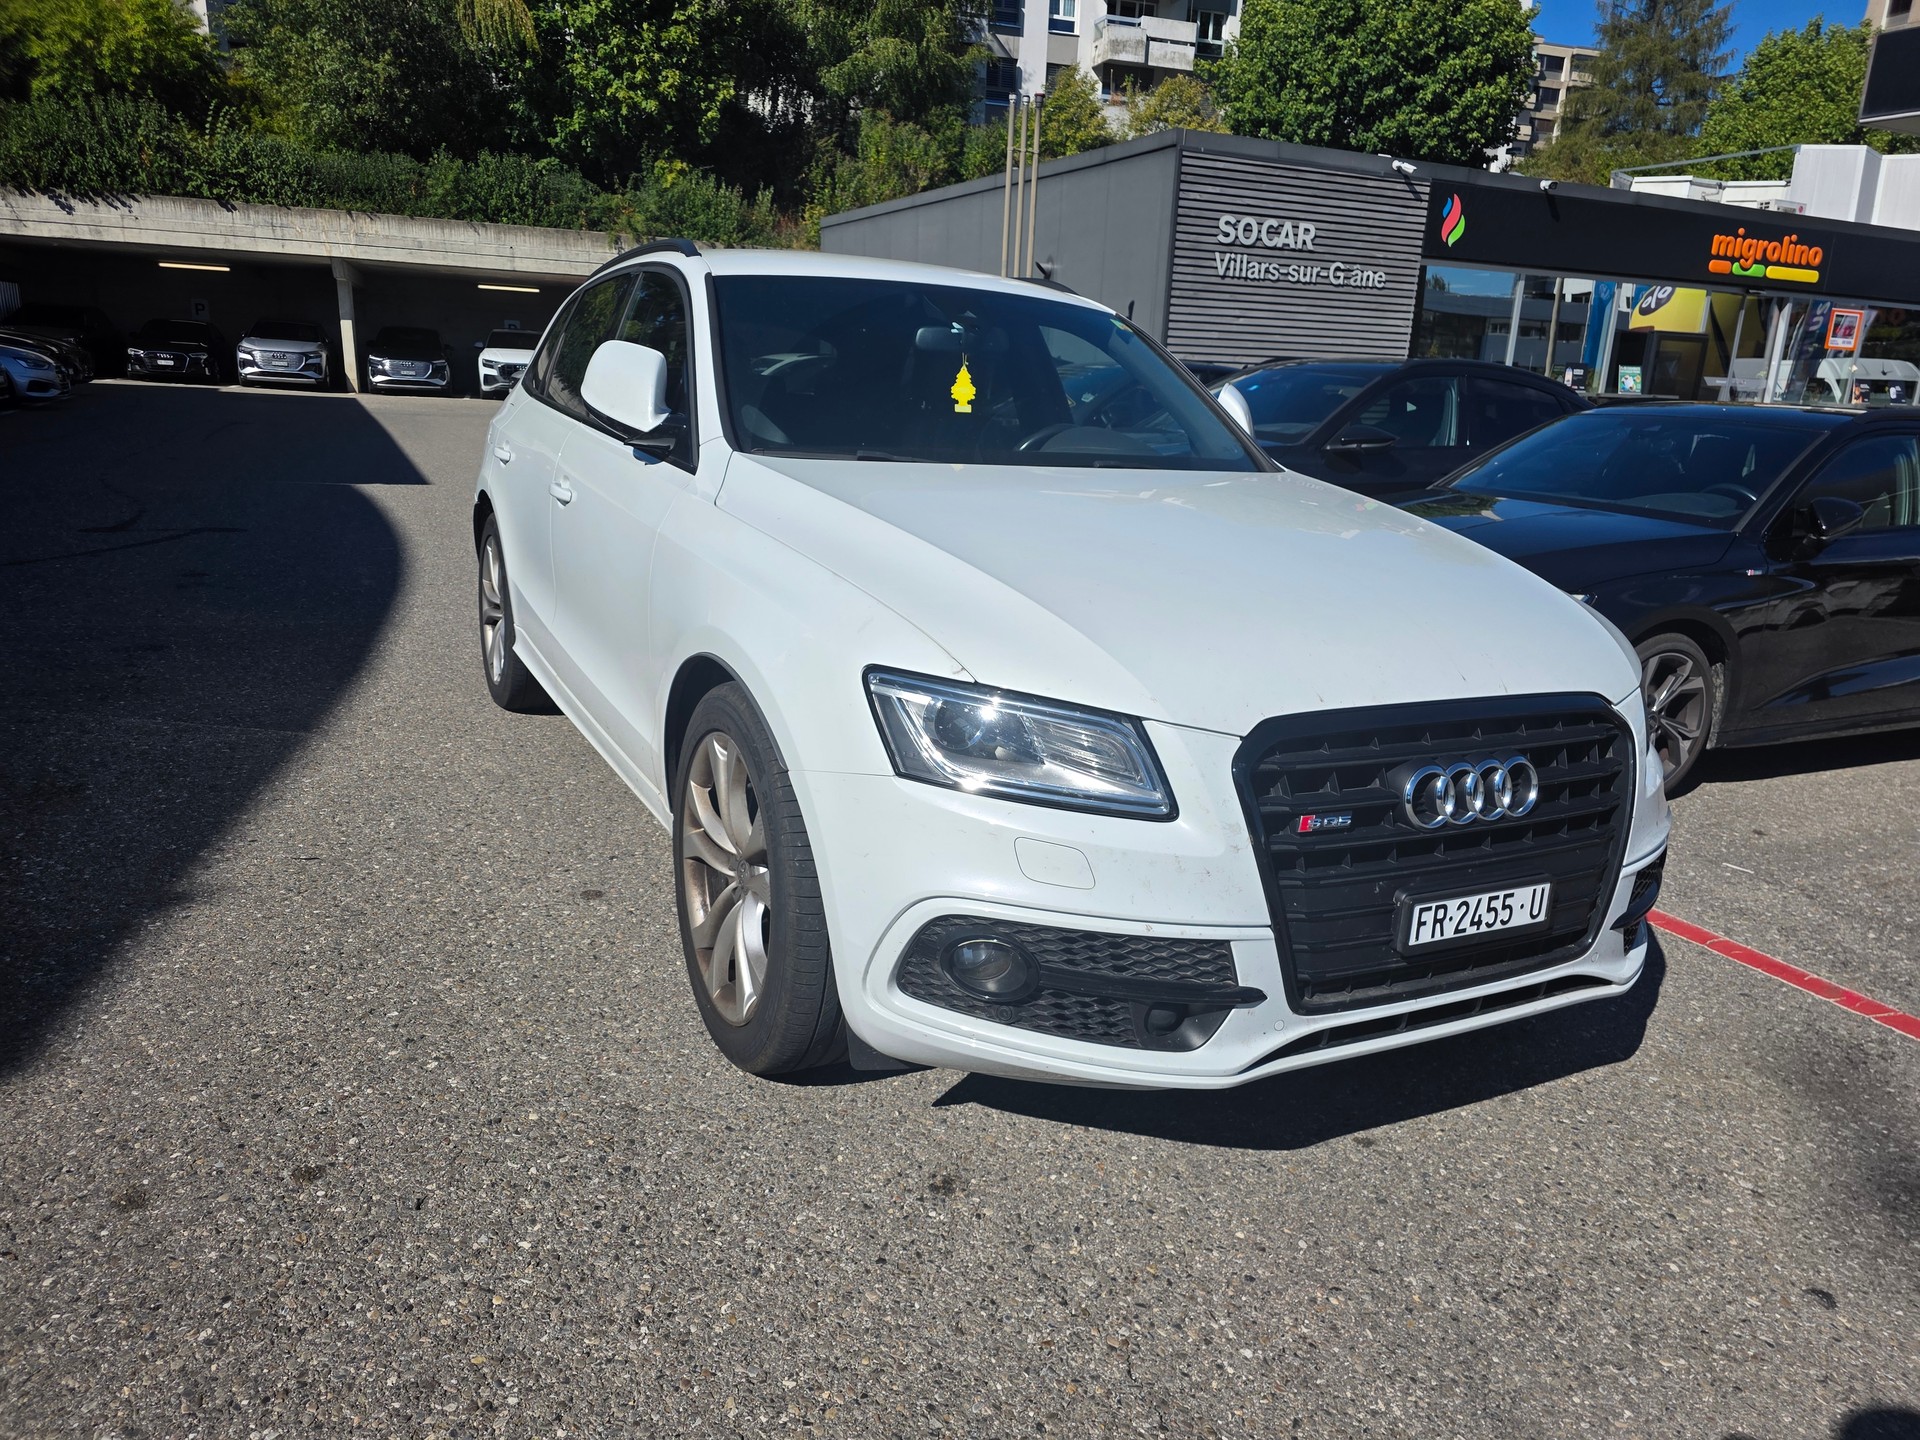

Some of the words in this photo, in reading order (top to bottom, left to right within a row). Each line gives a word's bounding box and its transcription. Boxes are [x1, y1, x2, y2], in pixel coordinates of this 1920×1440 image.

[1216, 215, 1316, 250] SOCAR
[1711, 227, 1823, 268] migrolino
[195, 303, 206, 315] P
